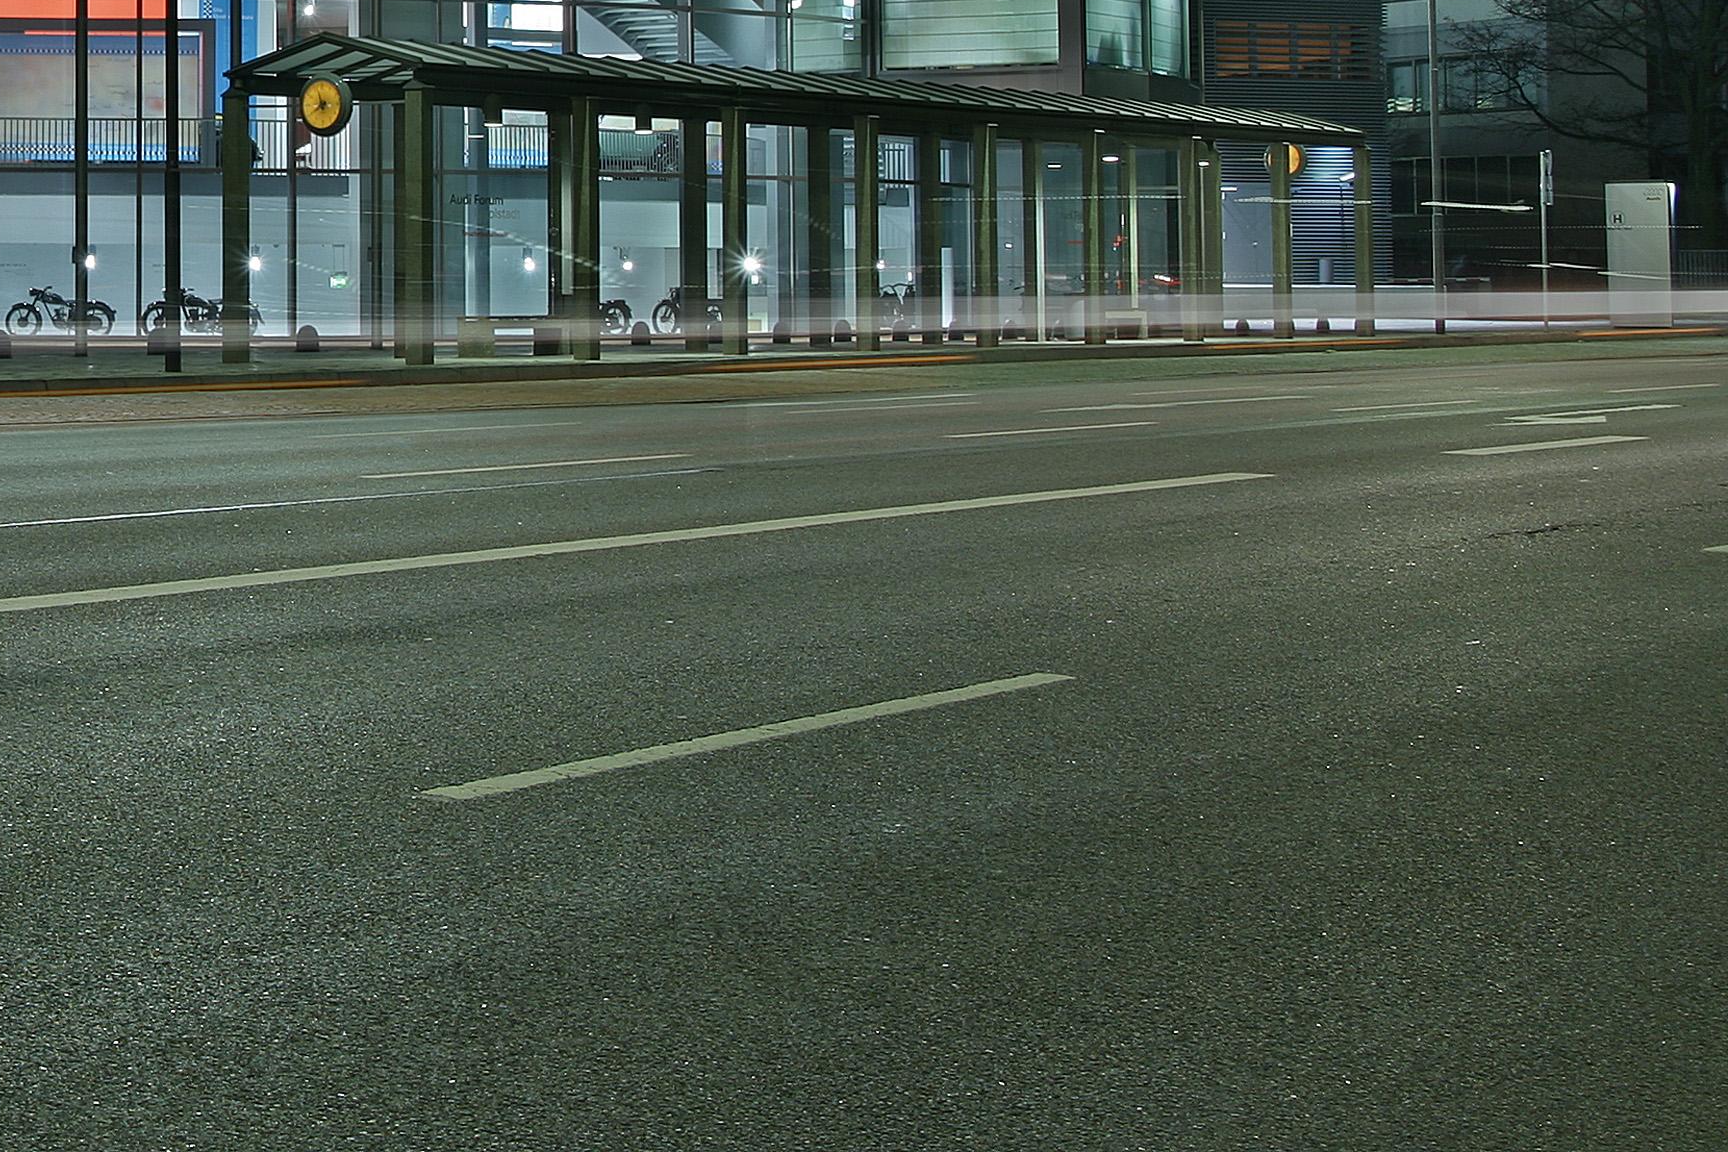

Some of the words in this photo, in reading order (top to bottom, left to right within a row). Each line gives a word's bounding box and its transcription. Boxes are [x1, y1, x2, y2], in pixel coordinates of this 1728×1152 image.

[450, 193, 472, 205] Audi
[474, 193, 504, 206] Forum
[1613, 214, 1622, 224] H
